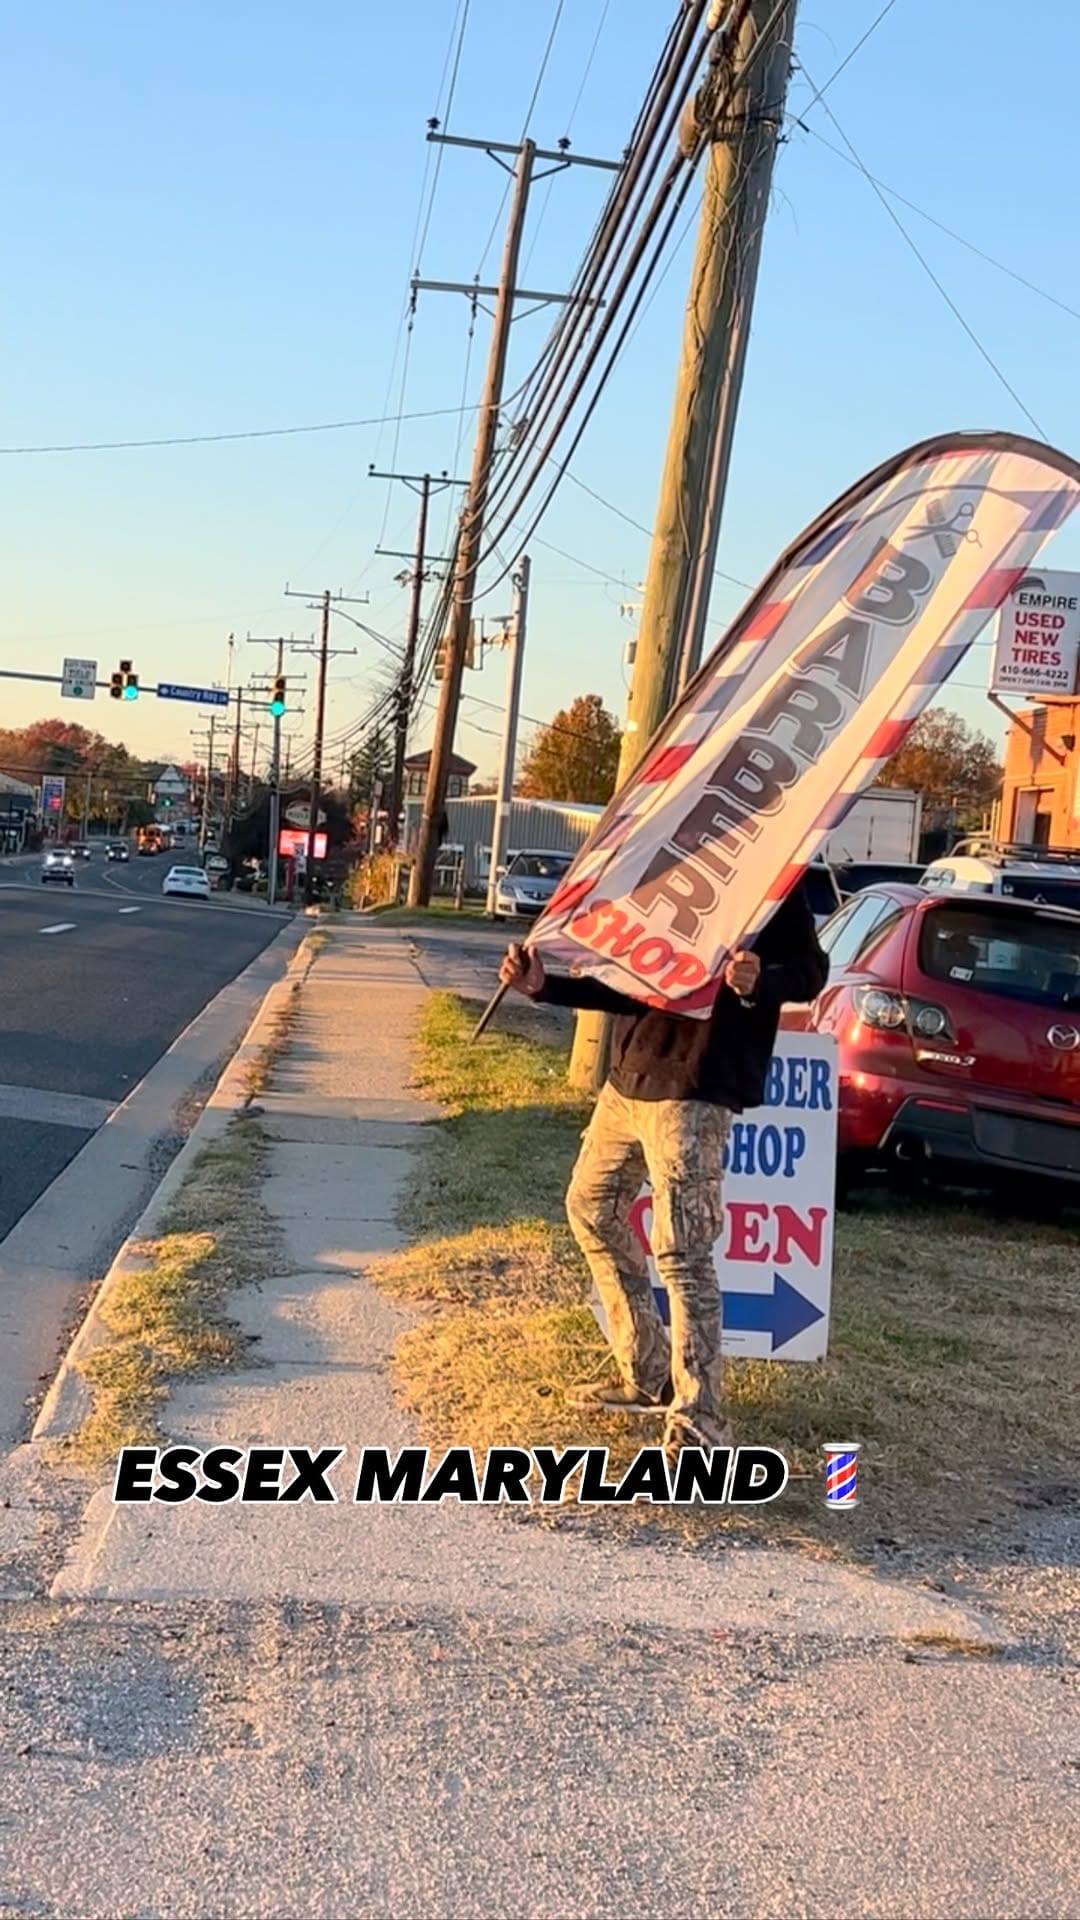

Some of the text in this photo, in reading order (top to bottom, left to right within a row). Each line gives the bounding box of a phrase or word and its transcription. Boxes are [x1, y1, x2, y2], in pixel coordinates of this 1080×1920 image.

[1019, 593, 1078, 610] EMPIRE
[1015, 611, 1065, 629] USED
[1014, 630, 1059, 646] NEW
[1011, 648, 1062, 666] TIRES
[630, 537, 931, 944] BARBER
[572, 899, 706, 989] SHOP
[763, 1056, 832, 1111] BER
